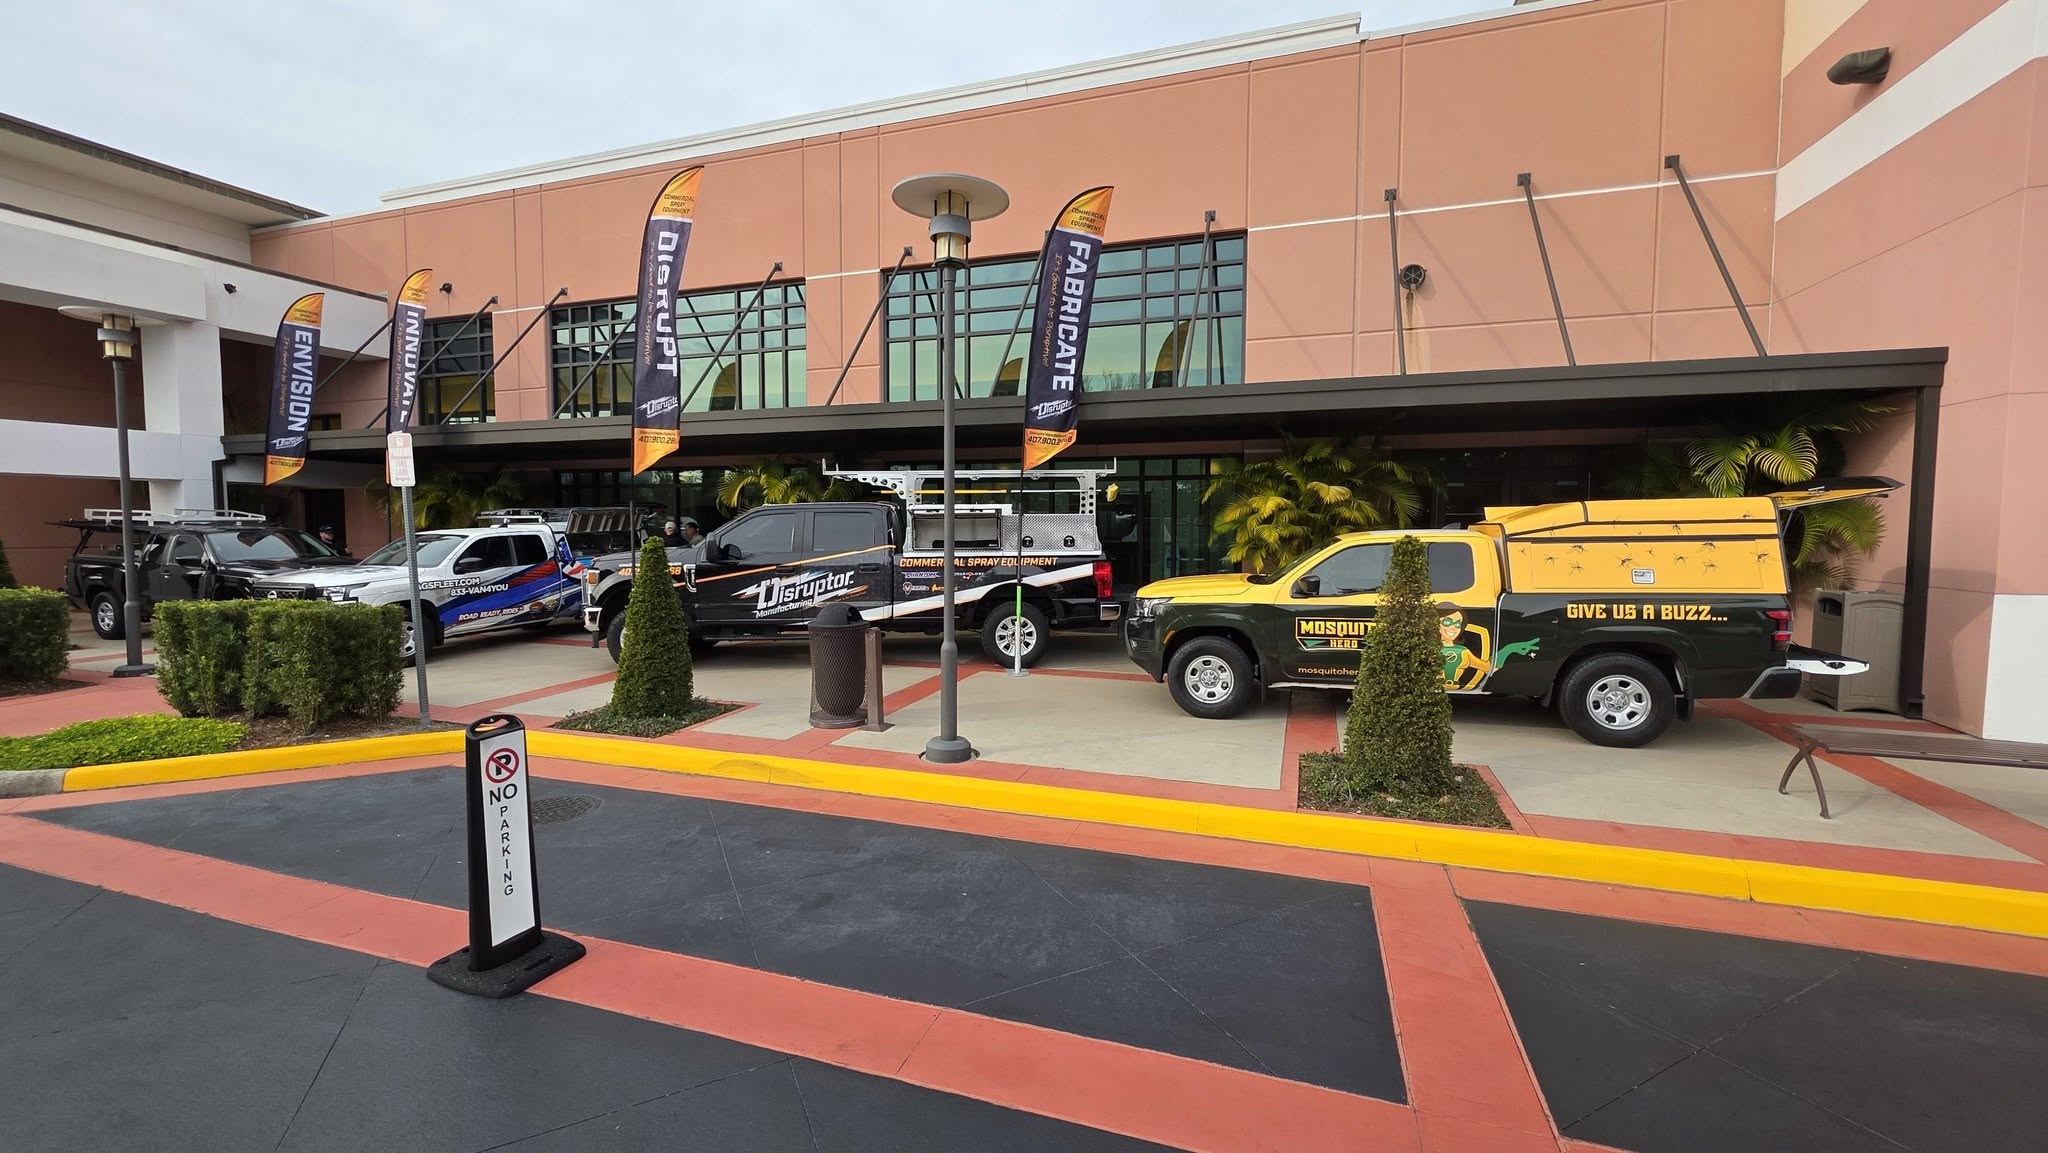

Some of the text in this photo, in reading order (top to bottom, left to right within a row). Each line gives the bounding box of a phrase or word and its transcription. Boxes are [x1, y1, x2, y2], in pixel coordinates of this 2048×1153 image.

[663, 193, 695, 202] COMMERCIAL
[669, 200, 686, 208] SPRAY
[662, 206, 690, 215] EQUIPMENT
[1071, 207, 1106, 221] COMMERCIAL
[1070, 219, 1102, 232] EQUIPMENT
[1078, 215, 1097, 224] SPRAY
[656, 231, 678, 377] DISRUPT
[1042, 252, 1064, 367] It's Good to be Disruptive!
[1052, 240, 1091, 391] FABRICATE
[287, 330, 312, 431] ENVISION
[899, 557, 965, 568] COMMERAL
[967, 557, 1000, 567] SPRAY
[450, 583, 509, 596] 833-VAN4YOU
[756, 571, 855, 610] Disruptor
[752, 599, 813, 618] Manufacturing
[1566, 603, 1728, 621] GIVE US A BUZZ...
[1300, 621, 1377, 637] MOSQUIT
[1329, 640, 1358, 648] HERO
[1298, 667, 1361, 676] mosquitoher
[489, 783, 518, 806] NO
[499, 805, 515, 896] PARKING
